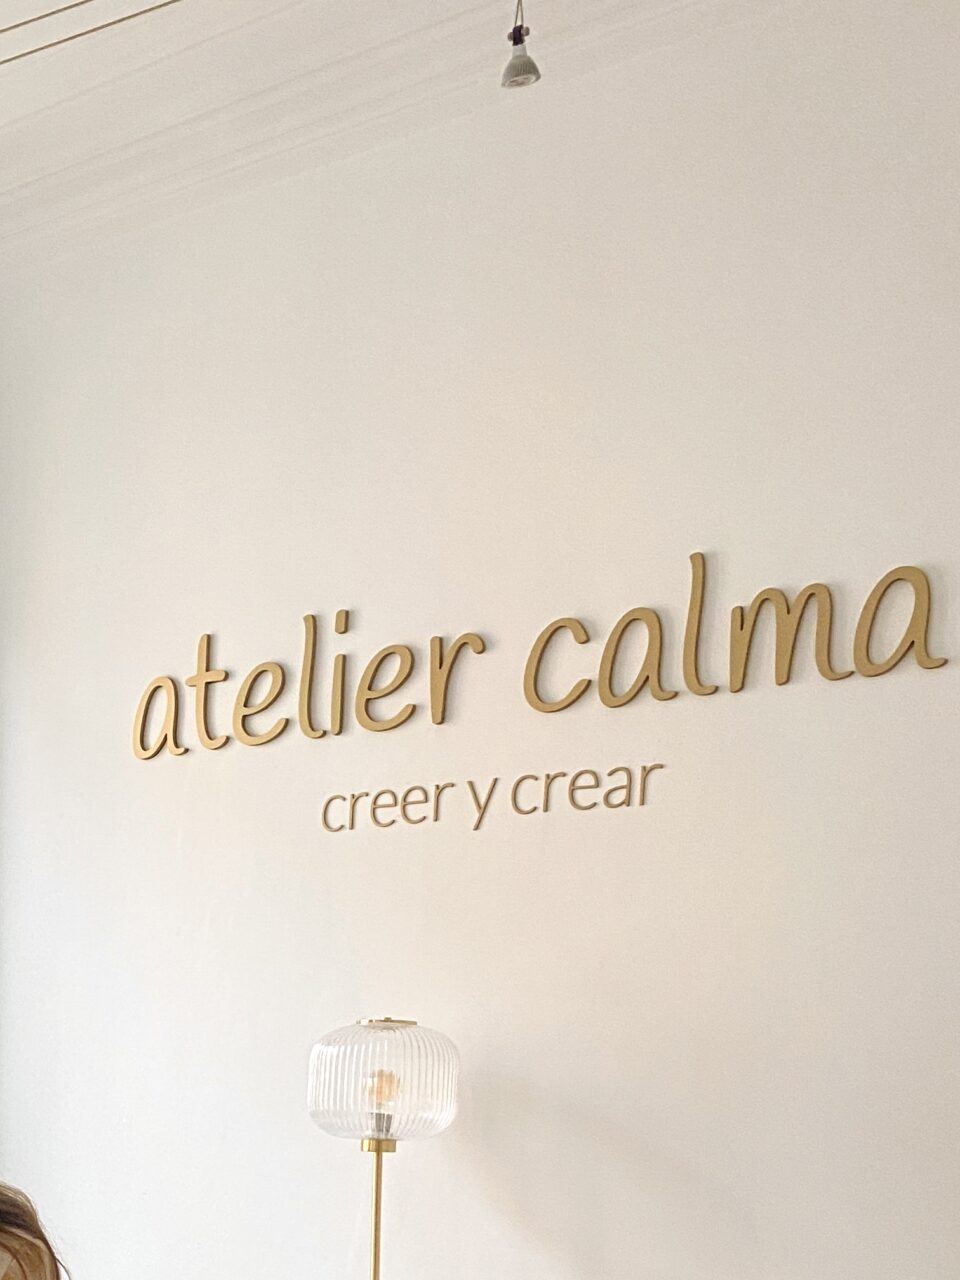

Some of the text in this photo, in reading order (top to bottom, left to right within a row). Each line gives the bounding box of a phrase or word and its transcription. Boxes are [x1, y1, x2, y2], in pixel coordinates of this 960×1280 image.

[132, 551, 950, 760] atelier calma
[320, 762, 665, 833] creer y crear
